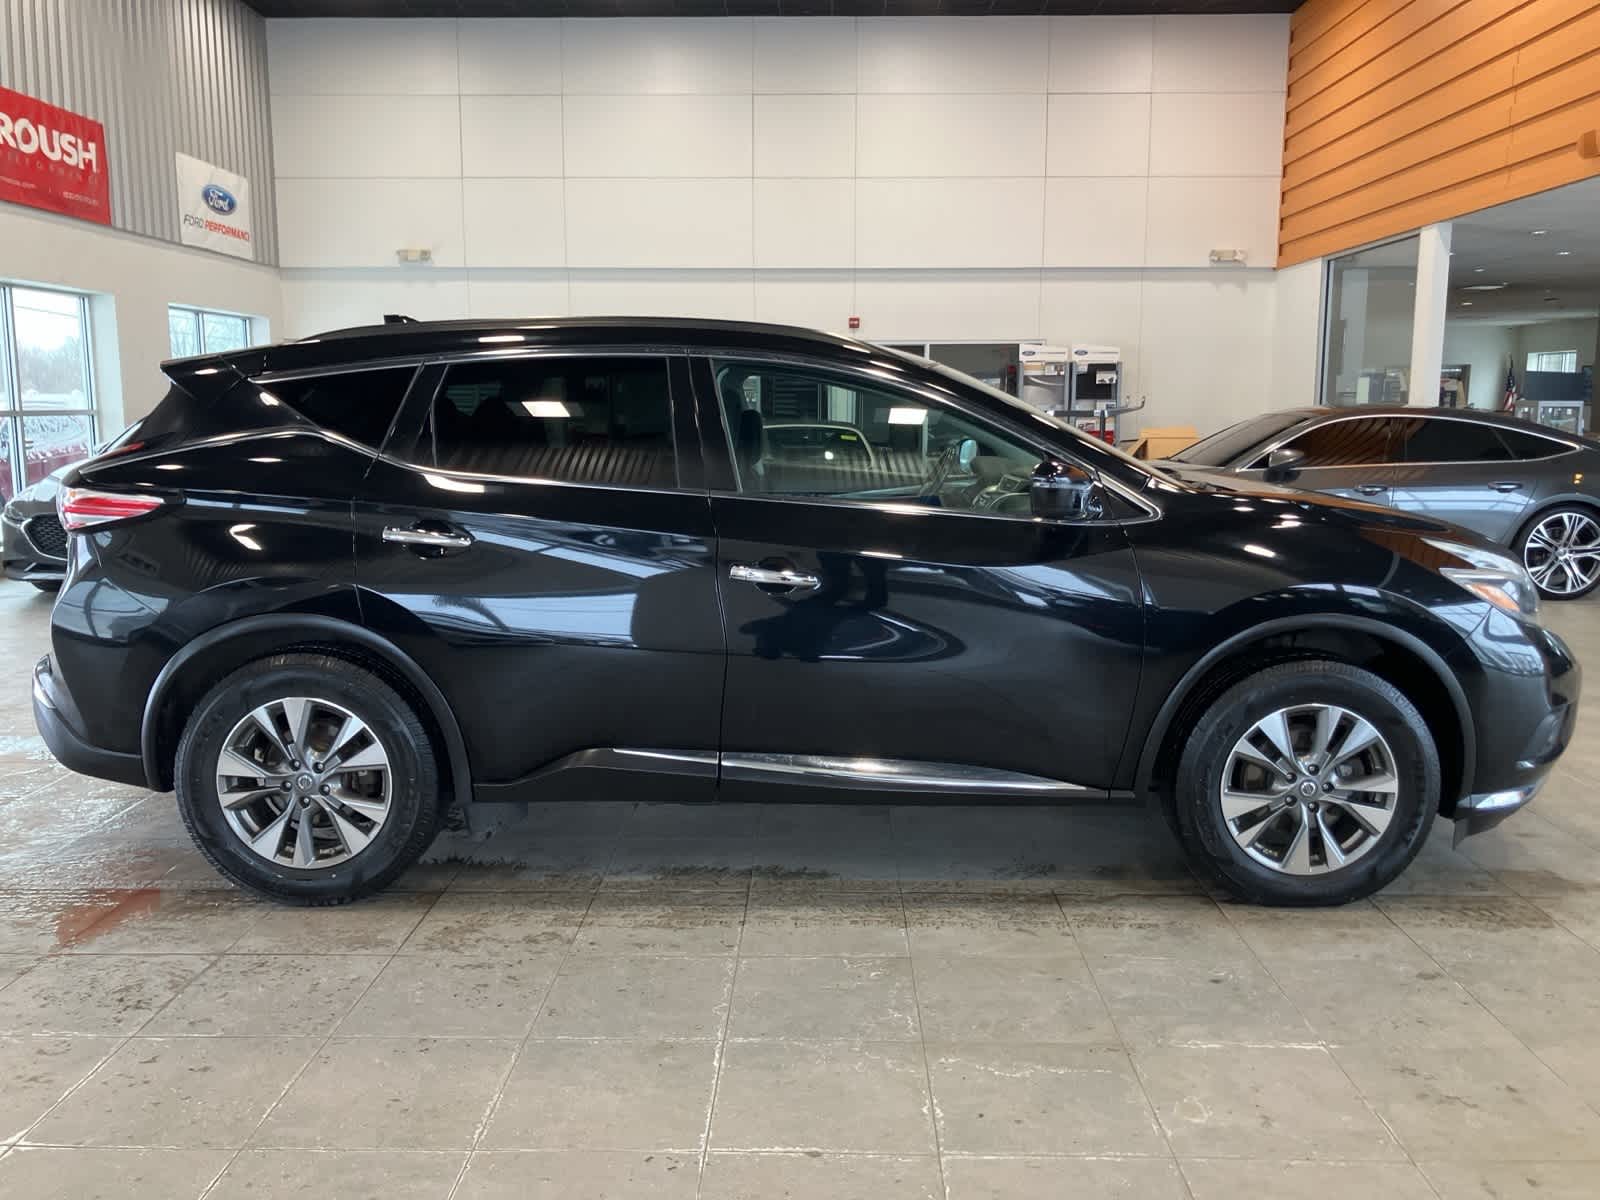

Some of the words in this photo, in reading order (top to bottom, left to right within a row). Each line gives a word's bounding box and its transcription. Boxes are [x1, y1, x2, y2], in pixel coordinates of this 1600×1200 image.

[0, 112, 97, 173] ROUSH
[207, 188, 231, 212] Ford
[183, 214, 204, 229] FORD
